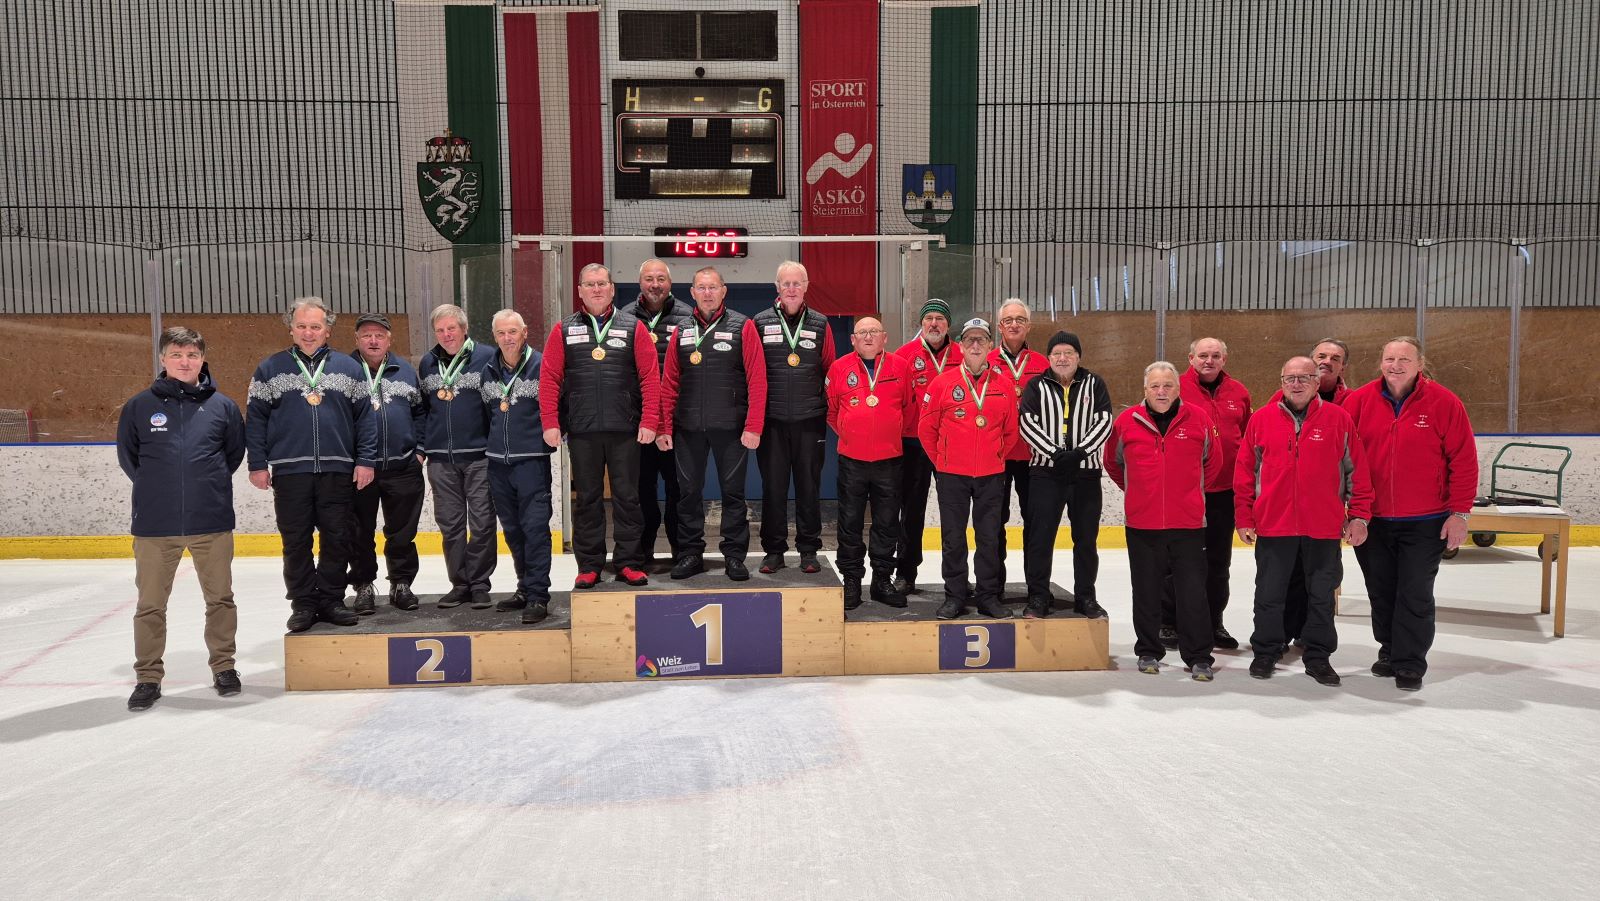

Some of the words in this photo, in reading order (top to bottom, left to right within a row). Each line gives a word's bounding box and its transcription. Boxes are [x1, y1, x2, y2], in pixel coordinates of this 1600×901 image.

[625, 86, 640, 111] H
[758, 87, 772, 112] G
[811, 82, 866, 98] SPORT
[811, 101, 820, 109] in
[822, 98, 866, 109] Österreich
[813, 185, 866, 205] ASKÖ
[812, 204, 866, 216] Steiermark
[690, 603, 722, 665] 1
[965, 625, 991, 668] 3
[415, 638, 445, 682] 2
[657, 655, 682, 667] Weiz
